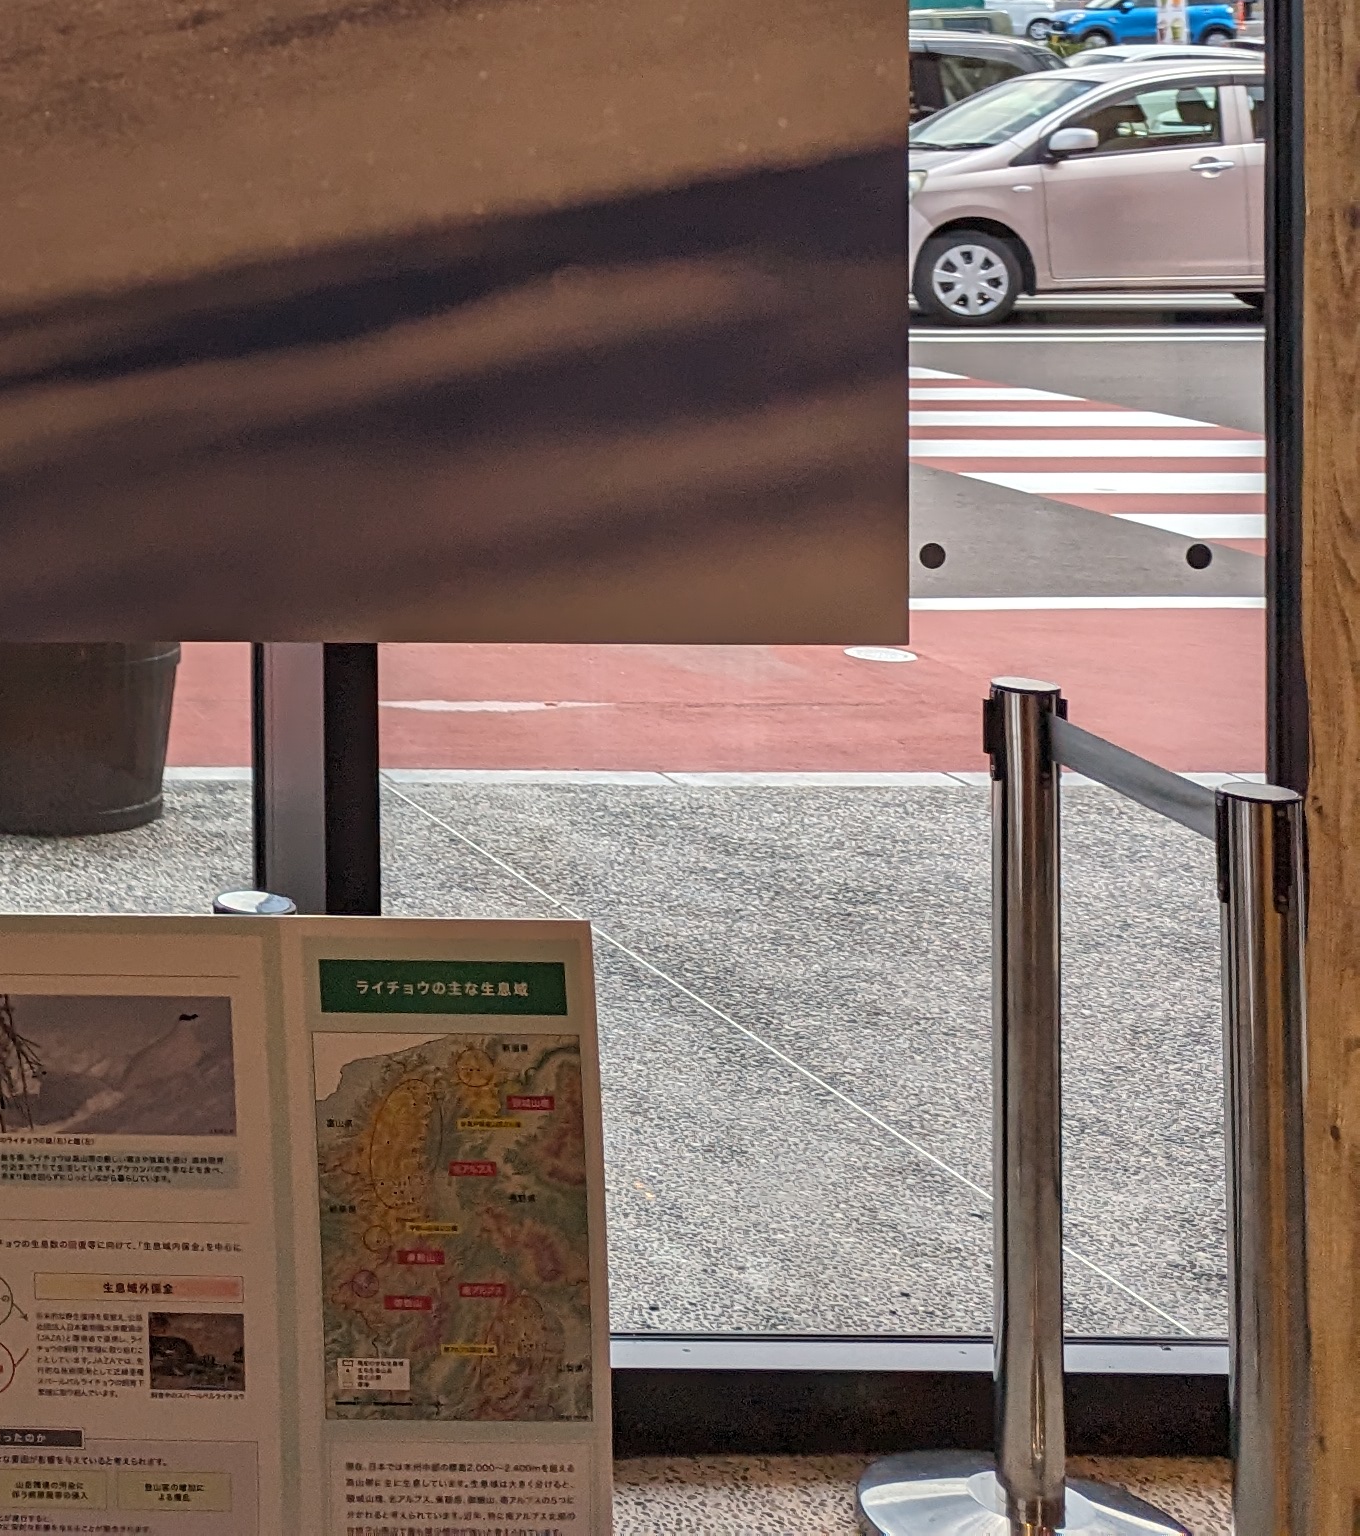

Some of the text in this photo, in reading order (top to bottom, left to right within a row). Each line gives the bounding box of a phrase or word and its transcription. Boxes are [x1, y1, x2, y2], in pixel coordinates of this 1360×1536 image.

[356, 980, 529, 997] ライチョウの主な生息域
